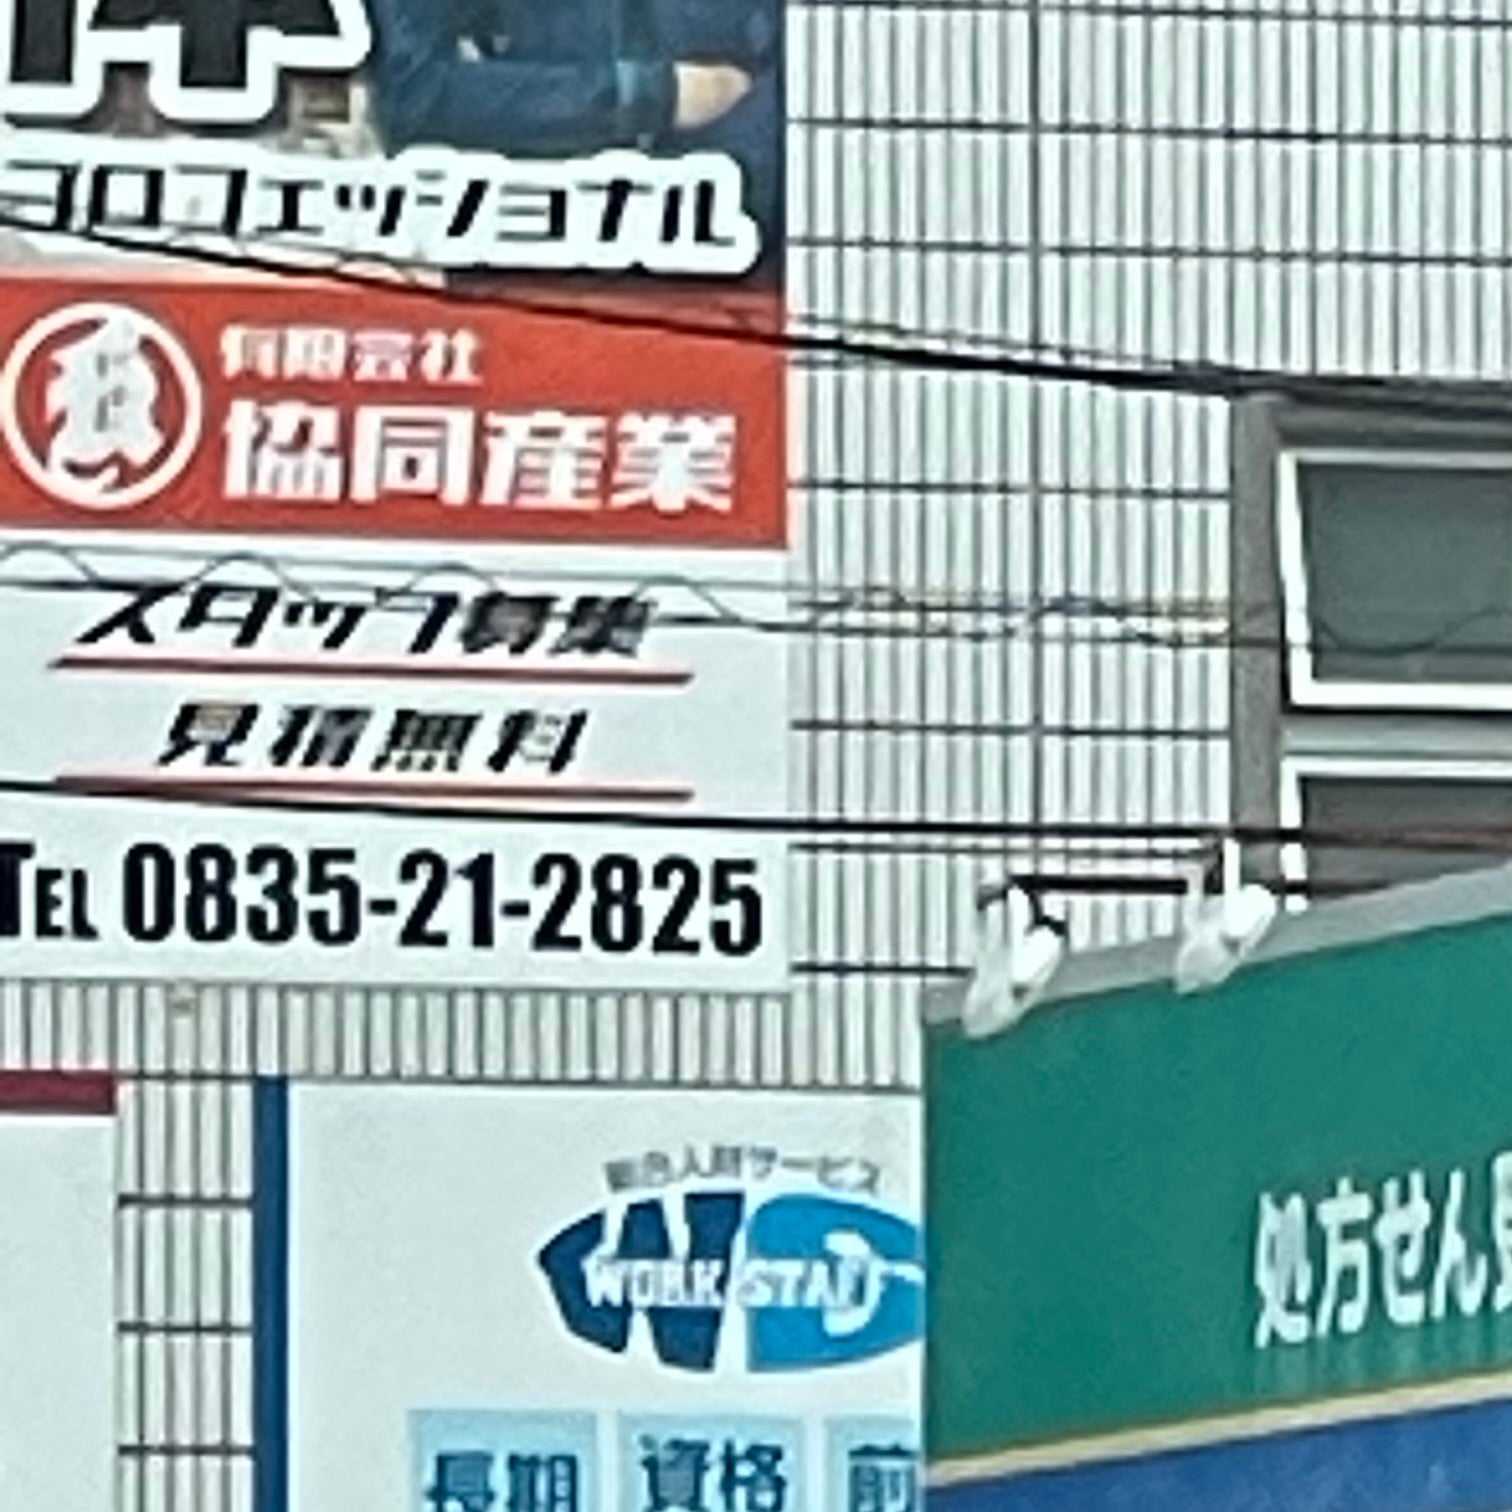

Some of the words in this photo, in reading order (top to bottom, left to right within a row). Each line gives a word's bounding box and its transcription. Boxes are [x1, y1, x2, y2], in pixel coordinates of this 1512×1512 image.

[221, 400, 739, 512] 協同産業
[76, 585, 662, 658] スタッフ募集
[157, 702, 590, 775] 見積無料
[122, 842, 764, 956] 0835-21-2825
[580, 1258, 724, 1309] WORK
